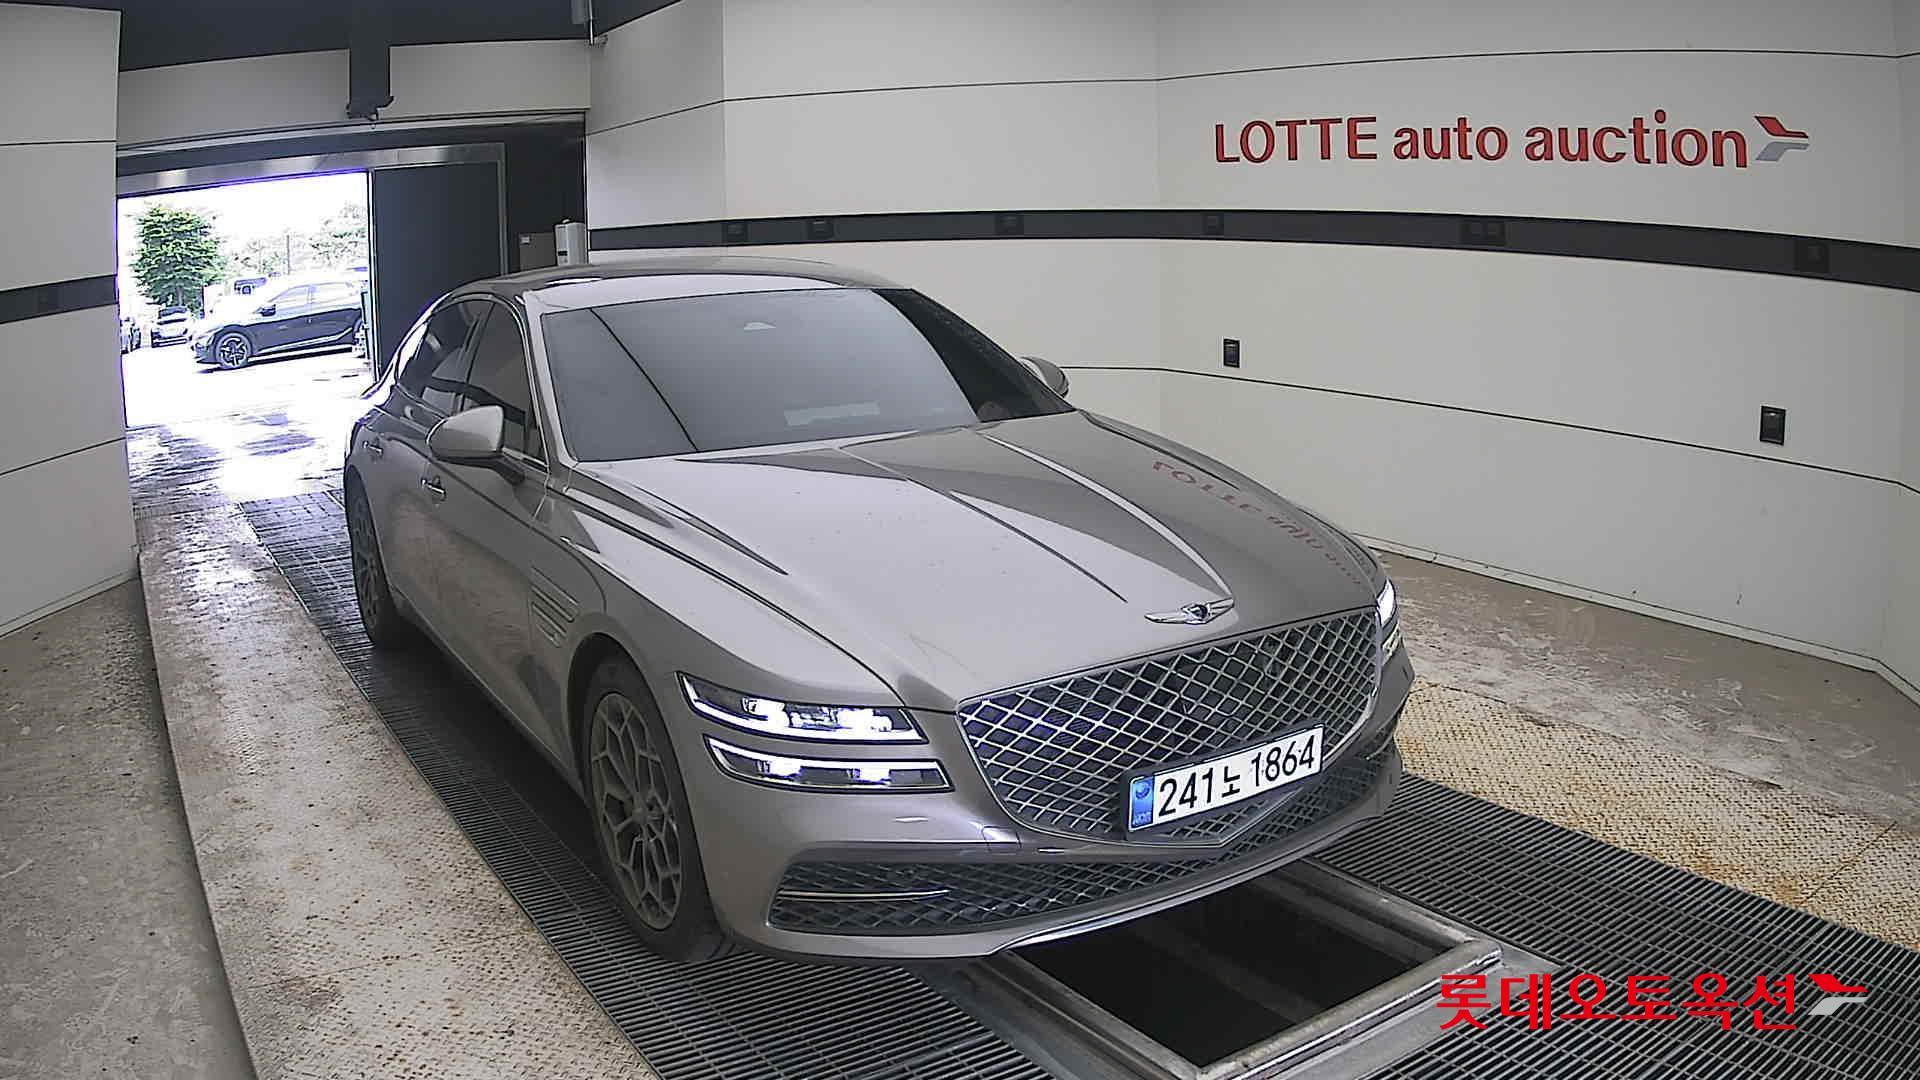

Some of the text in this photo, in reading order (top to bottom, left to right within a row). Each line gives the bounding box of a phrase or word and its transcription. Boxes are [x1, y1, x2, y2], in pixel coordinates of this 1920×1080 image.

[1214, 109, 1748, 168] LOTTE auto auction
[1157, 734, 1316, 818] 241노 1864
